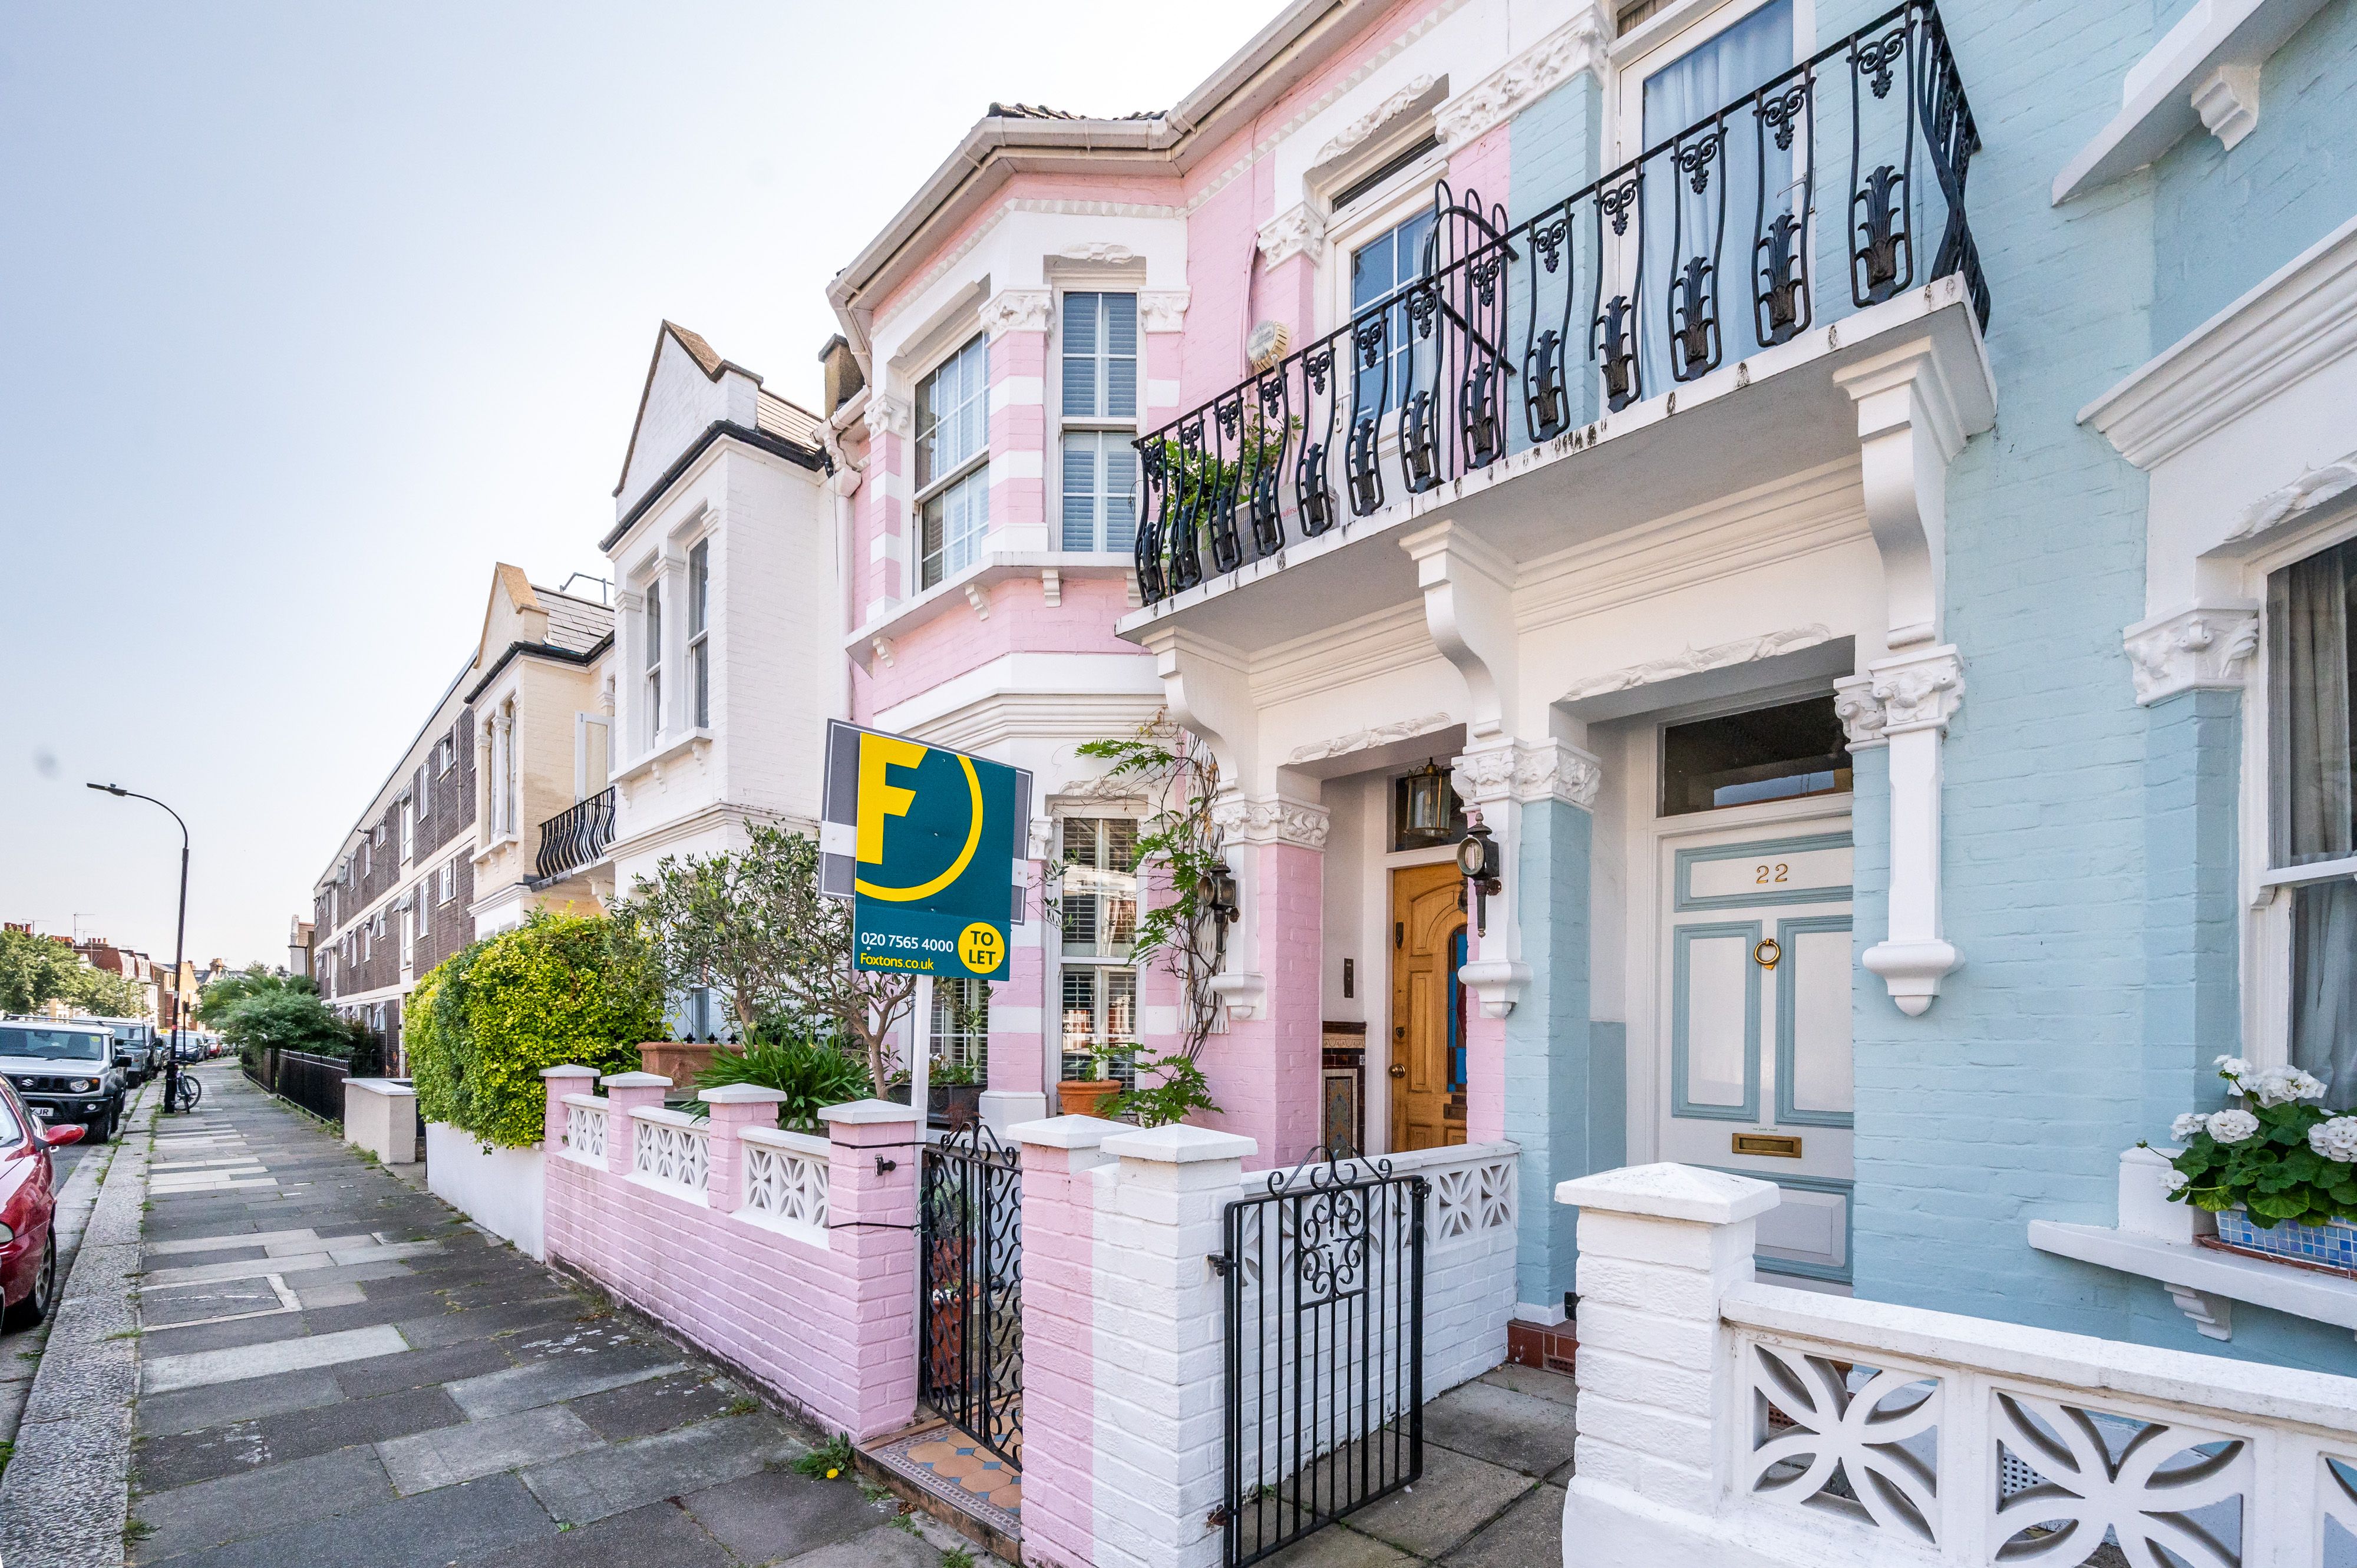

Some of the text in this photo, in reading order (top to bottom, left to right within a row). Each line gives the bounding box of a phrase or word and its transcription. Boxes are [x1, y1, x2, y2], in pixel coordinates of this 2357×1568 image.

[1756, 863, 1788, 884] 22
[861, 932, 954, 952] 020 7565 4000
[970, 930, 994, 946] TO
[860, 952, 934, 970] Foxtons.co.uk
[969, 949, 996, 965] LET
